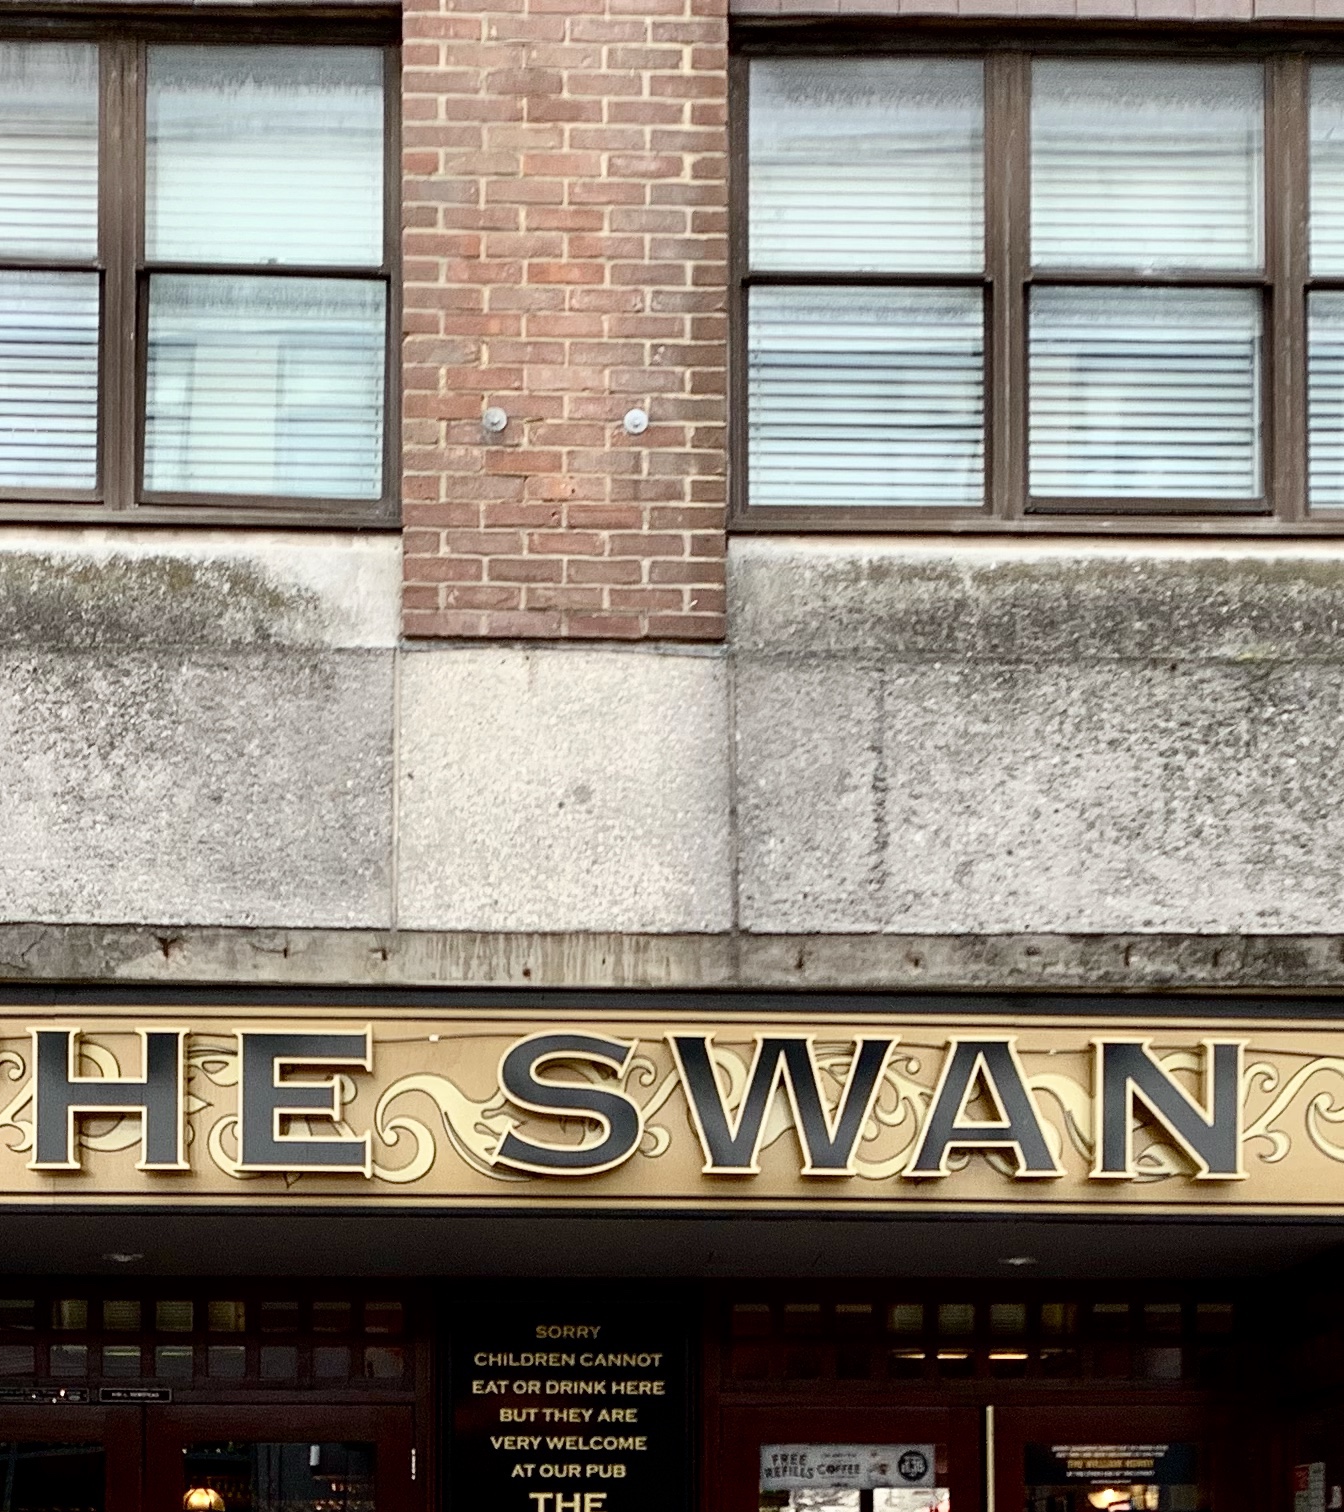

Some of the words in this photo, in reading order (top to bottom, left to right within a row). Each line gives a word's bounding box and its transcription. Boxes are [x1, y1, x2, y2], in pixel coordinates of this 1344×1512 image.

[489, 1030, 1251, 1181] SWAN
[535, 1325, 601, 1339] SORRY
[473, 1352, 575, 1367] CHILDREN
[579, 1353, 663, 1367] CANNOT
[472, 1380, 510, 1395] EAT
[513, 1380, 541, 1395] OR
[545, 1380, 606, 1395] DRINK
[611, 1380, 666, 1395] HERE
[499, 1408, 539, 1423] BUT
[542, 1408, 593, 1423] THEY
[597, 1408, 638, 1423] ARE
[490, 1436, 543, 1451] VERY
[545, 1436, 647, 1451] WELCOME
[771, 1453, 807, 1466] FREE
[511, 1464, 535, 1478] AT
[539, 1464, 581, 1479] OUR
[586, 1464, 626, 1478] PUB
[764, 1465, 814, 1479] REFILLS
[816, 1464, 860, 1475] COFFEE
